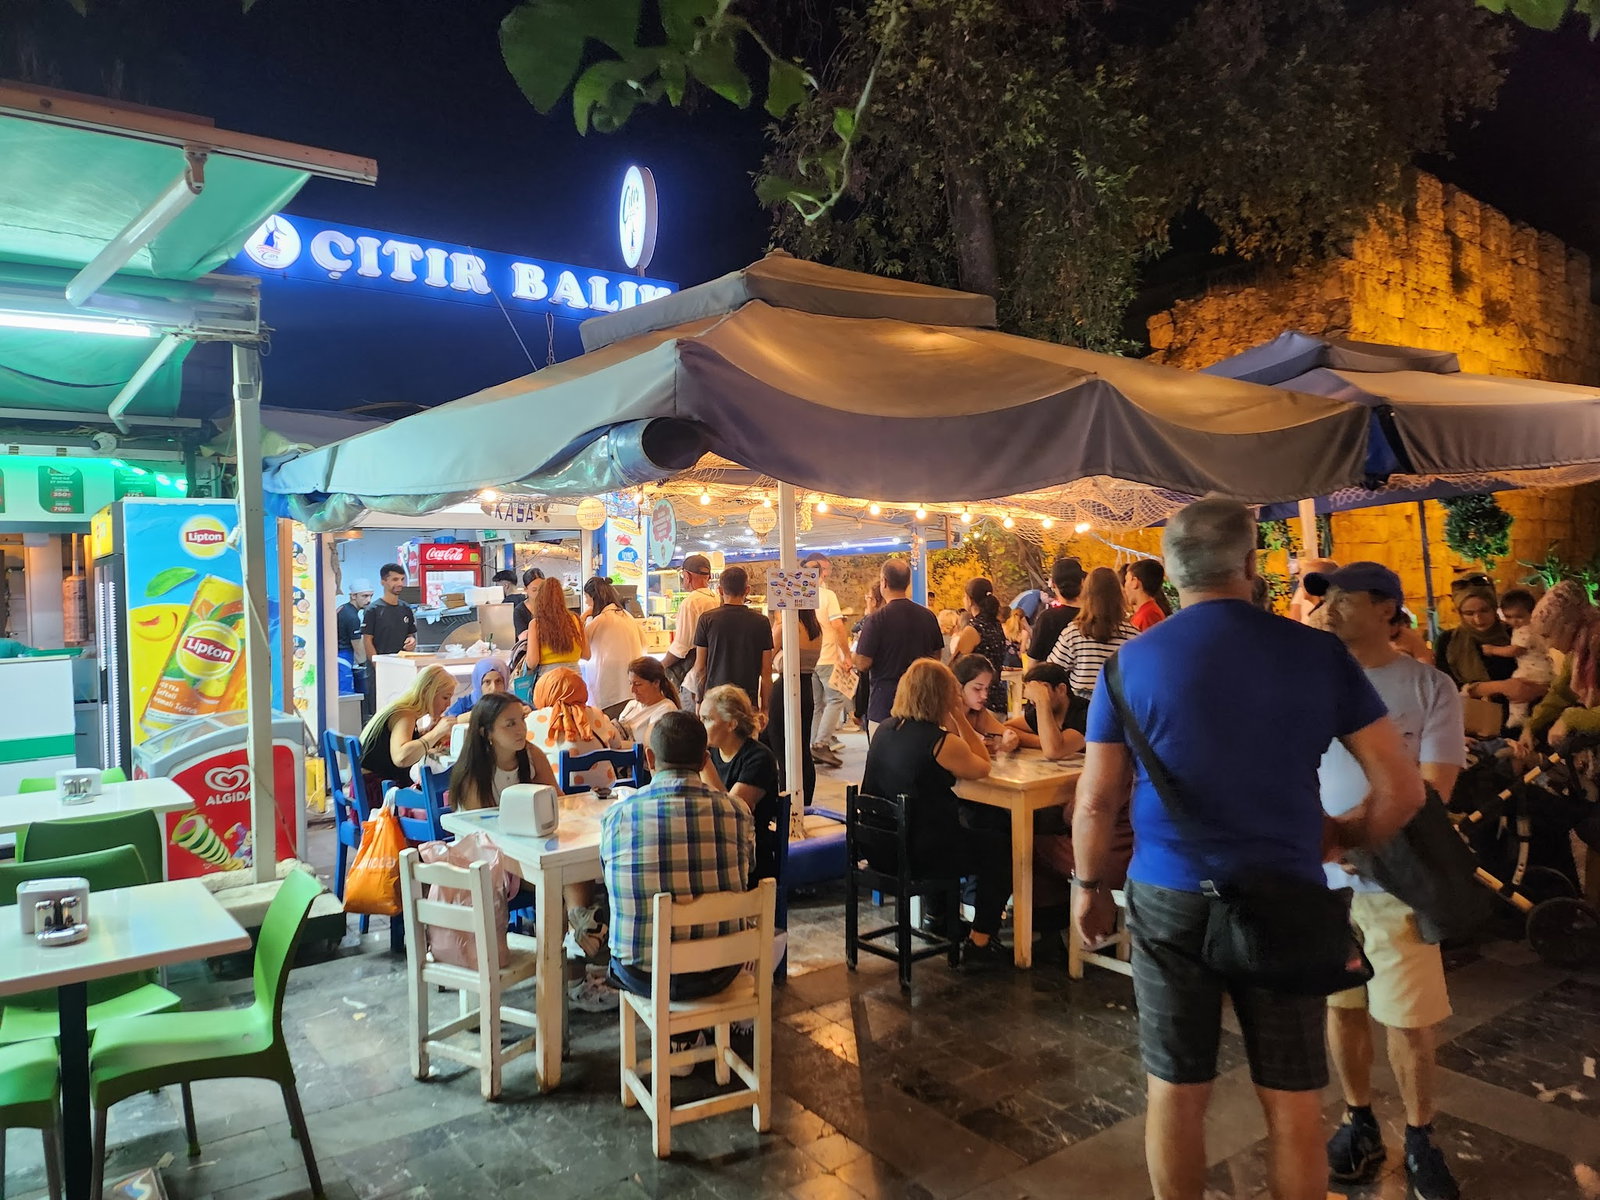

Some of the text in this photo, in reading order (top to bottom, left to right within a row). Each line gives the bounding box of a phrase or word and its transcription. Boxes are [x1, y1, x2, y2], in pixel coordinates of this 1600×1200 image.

[310, 230, 492, 295] ÇITIR
[187, 531, 223, 545] Lipton
[426, 546, 465, 561] Coca-Cola
[186, 636, 233, 662] Lipton
